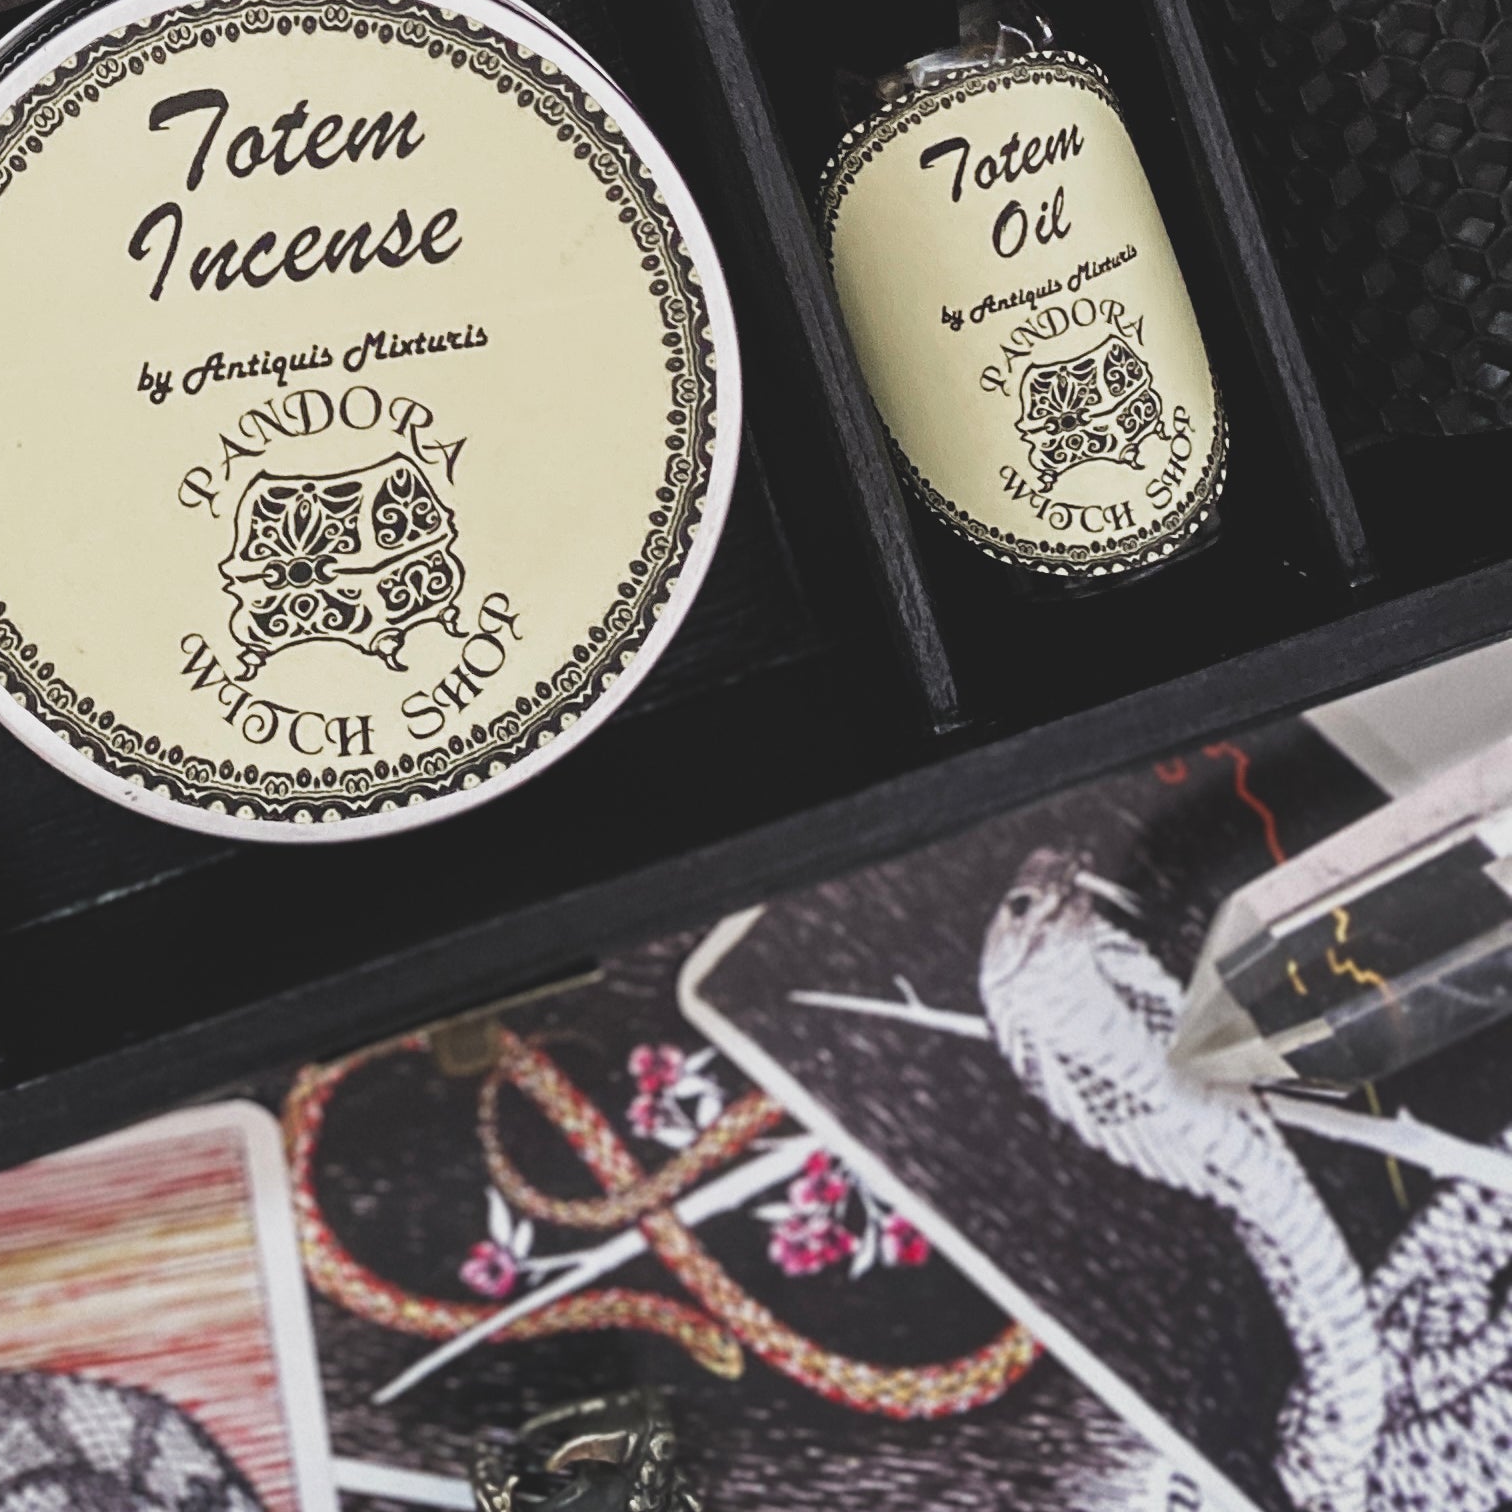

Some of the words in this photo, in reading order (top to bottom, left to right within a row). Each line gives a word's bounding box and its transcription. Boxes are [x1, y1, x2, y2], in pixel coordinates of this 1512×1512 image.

[148, 87, 426, 191] Totem
[920, 124, 1085, 202] Totem
[127, 202, 463, 303] Incense
[992, 185, 1071, 258] Oil
[941, 307, 964, 331] by
[970, 279, 1062, 322] Antiquis
[1068, 244, 1138, 293] Mixturis
[136, 361, 174, 405] by
[182, 343, 334, 398] Antiquis
[344, 324, 489, 372] Mixturis
[980, 298, 1145, 396] PANDORA
[177, 385, 468, 519] PANDORA
[999, 465, 1137, 533] WITCH
[1145, 405, 1195, 509] SHOP
[179, 632, 375, 757] WITCH
[400, 591, 520, 739] SHOP
